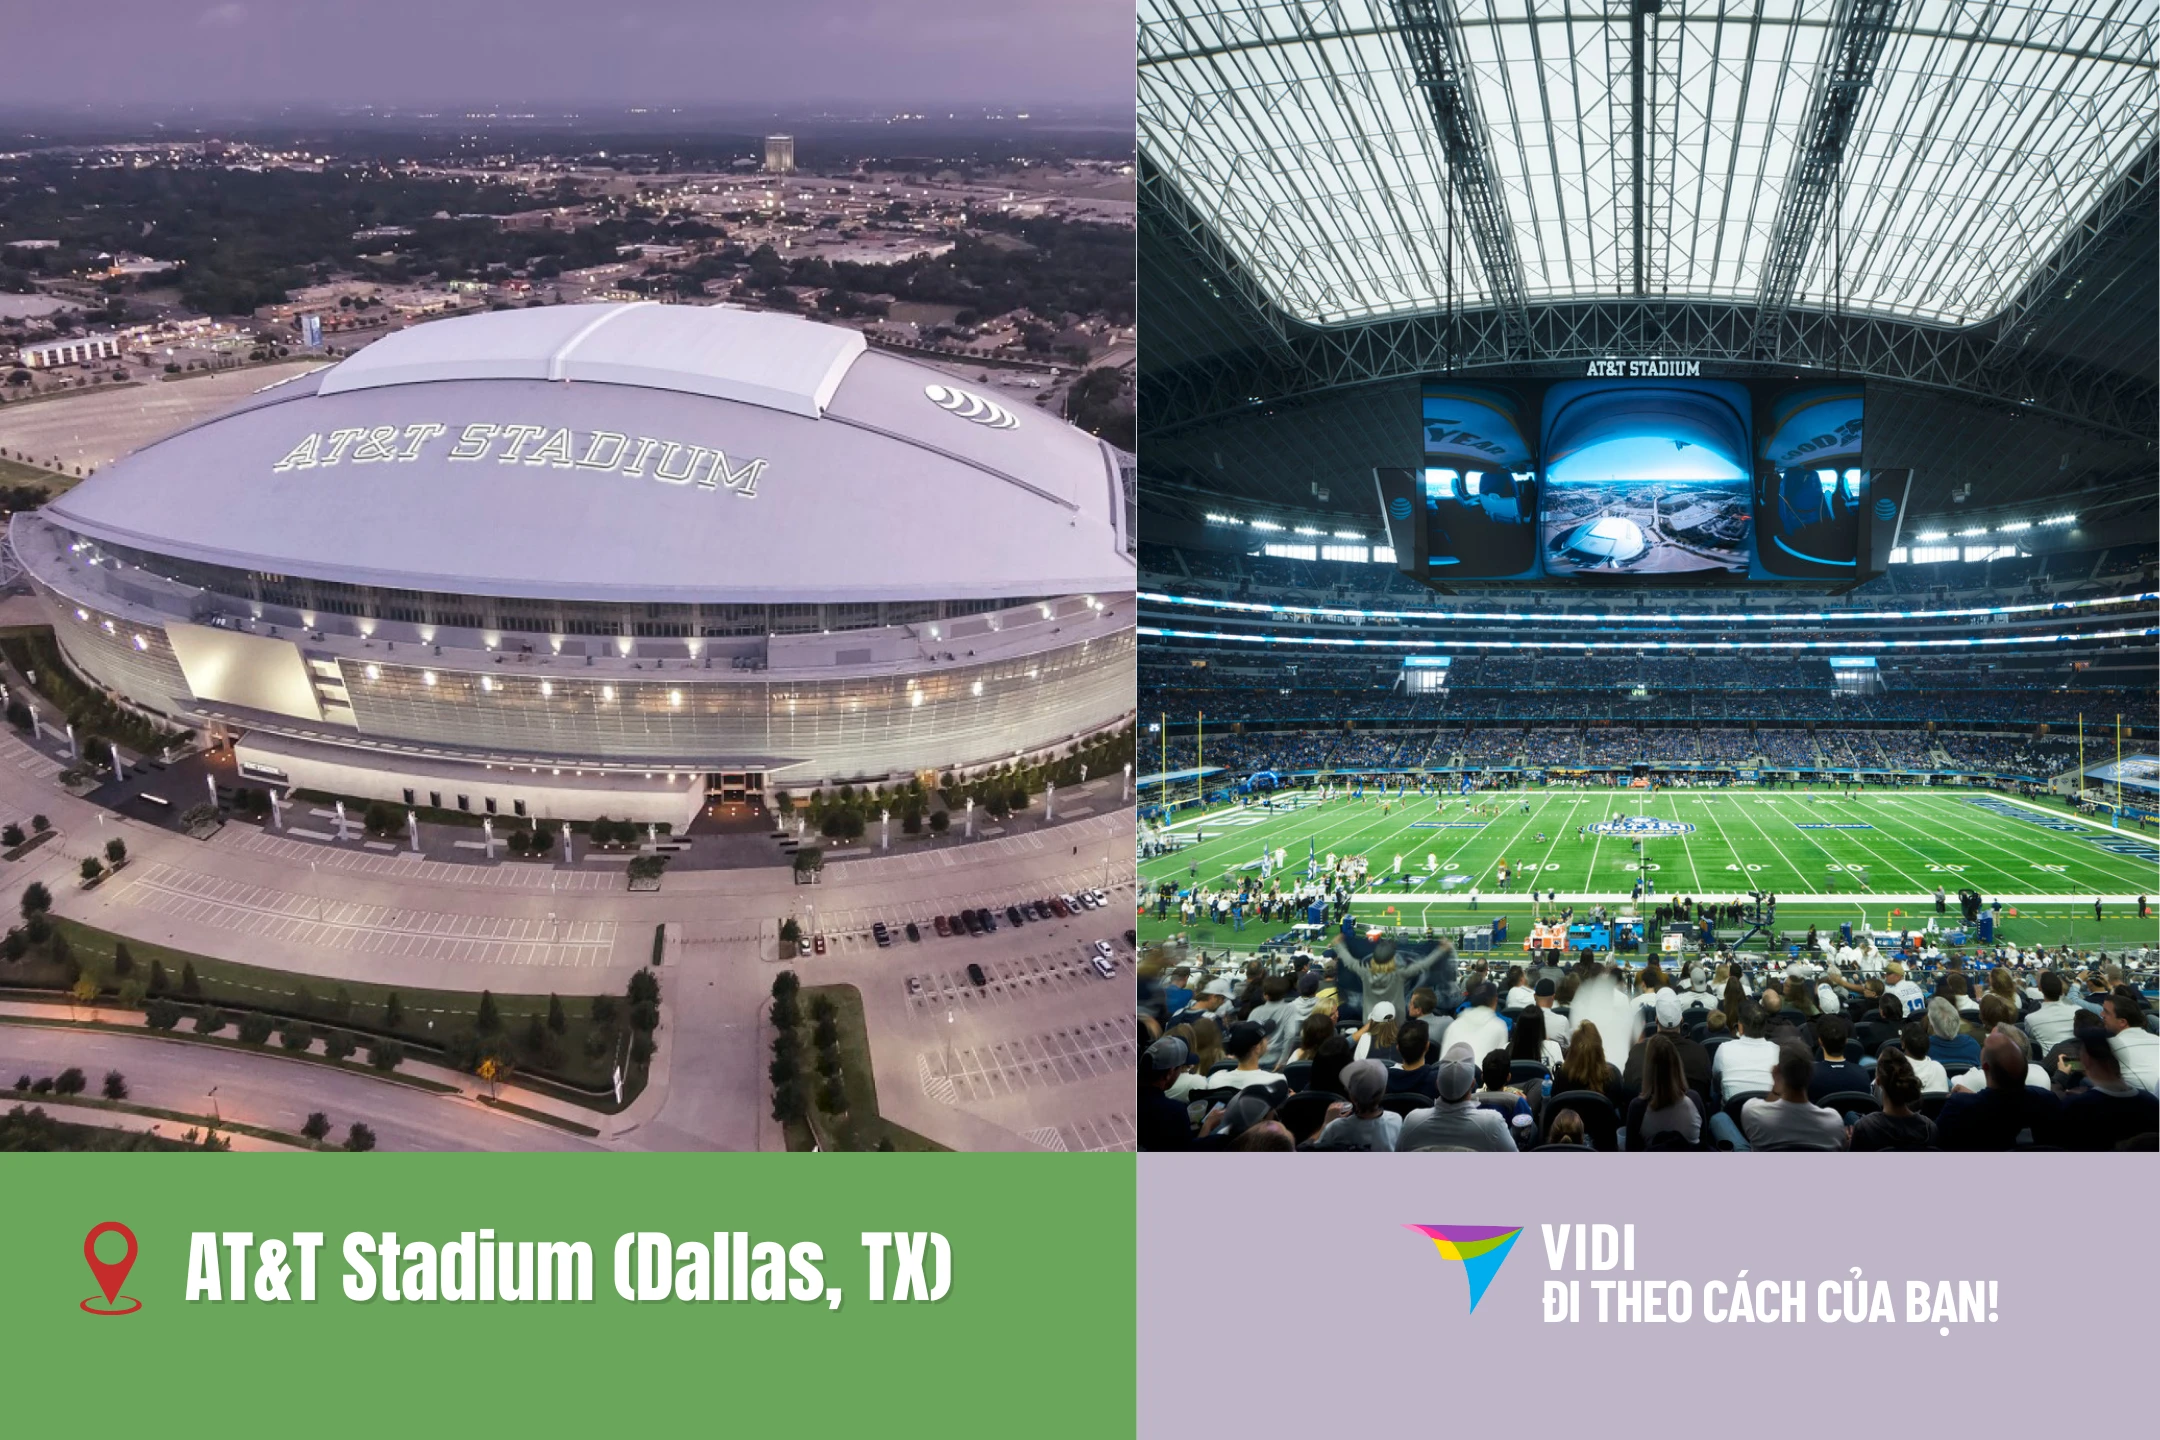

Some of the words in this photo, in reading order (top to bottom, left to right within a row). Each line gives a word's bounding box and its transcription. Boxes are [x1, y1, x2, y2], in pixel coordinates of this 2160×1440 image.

[1586, 360, 1627, 377] AT&T
[1629, 360, 1700, 377] STADIUM
[273, 422, 446, 474] AT&T
[447, 423, 769, 499] STADIUM
[1523, 863, 1560, 872] 40
[1725, 863, 1762, 872] 40
[1825, 863, 1864, 872] 30
[1925, 863, 1965, 872] 20
